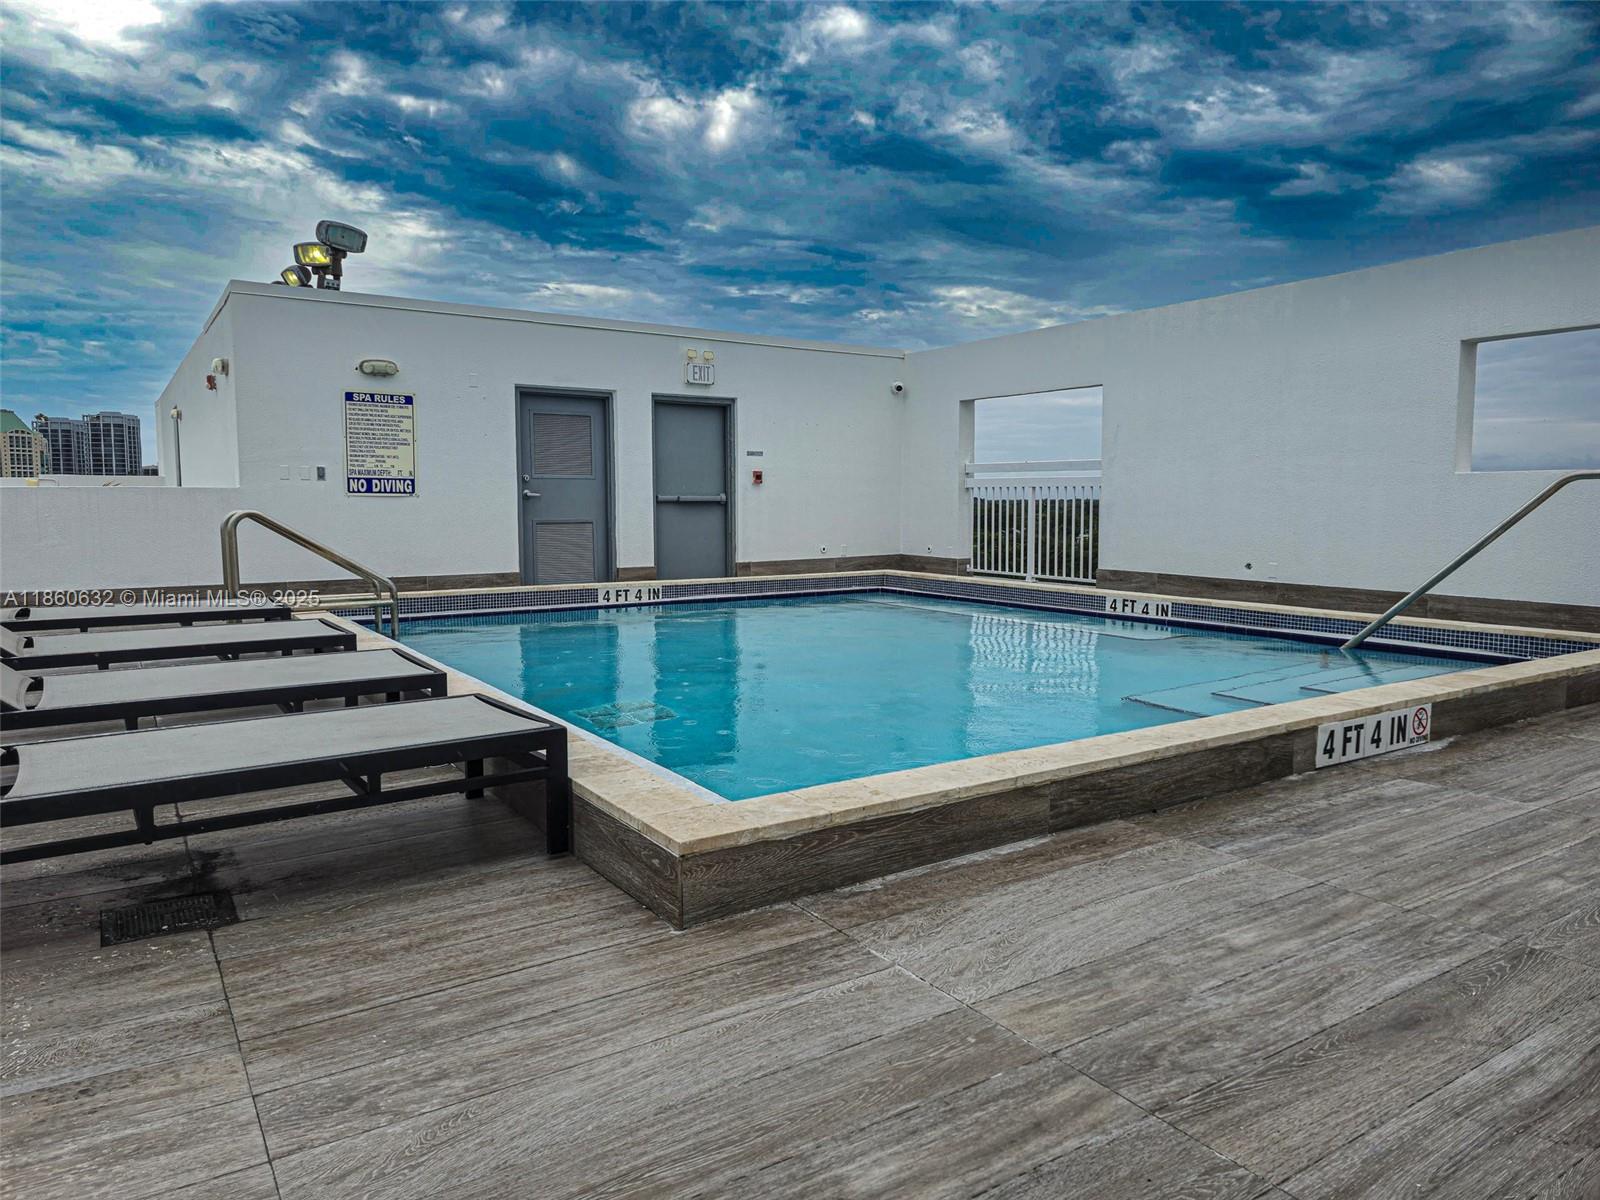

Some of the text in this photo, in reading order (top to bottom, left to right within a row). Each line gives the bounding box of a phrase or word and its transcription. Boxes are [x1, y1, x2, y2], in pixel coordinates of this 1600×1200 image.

[693, 365, 710, 382] EXIT
[352, 393, 406, 404] SPA RULES
[349, 478, 413, 493] NO DIVING
[603, 588, 660, 602] 4 FT 4 IN
[1109, 599, 1169, 617] 4 FT 4 IN
[1323, 714, 1408, 759] 4 FT 4 IN
